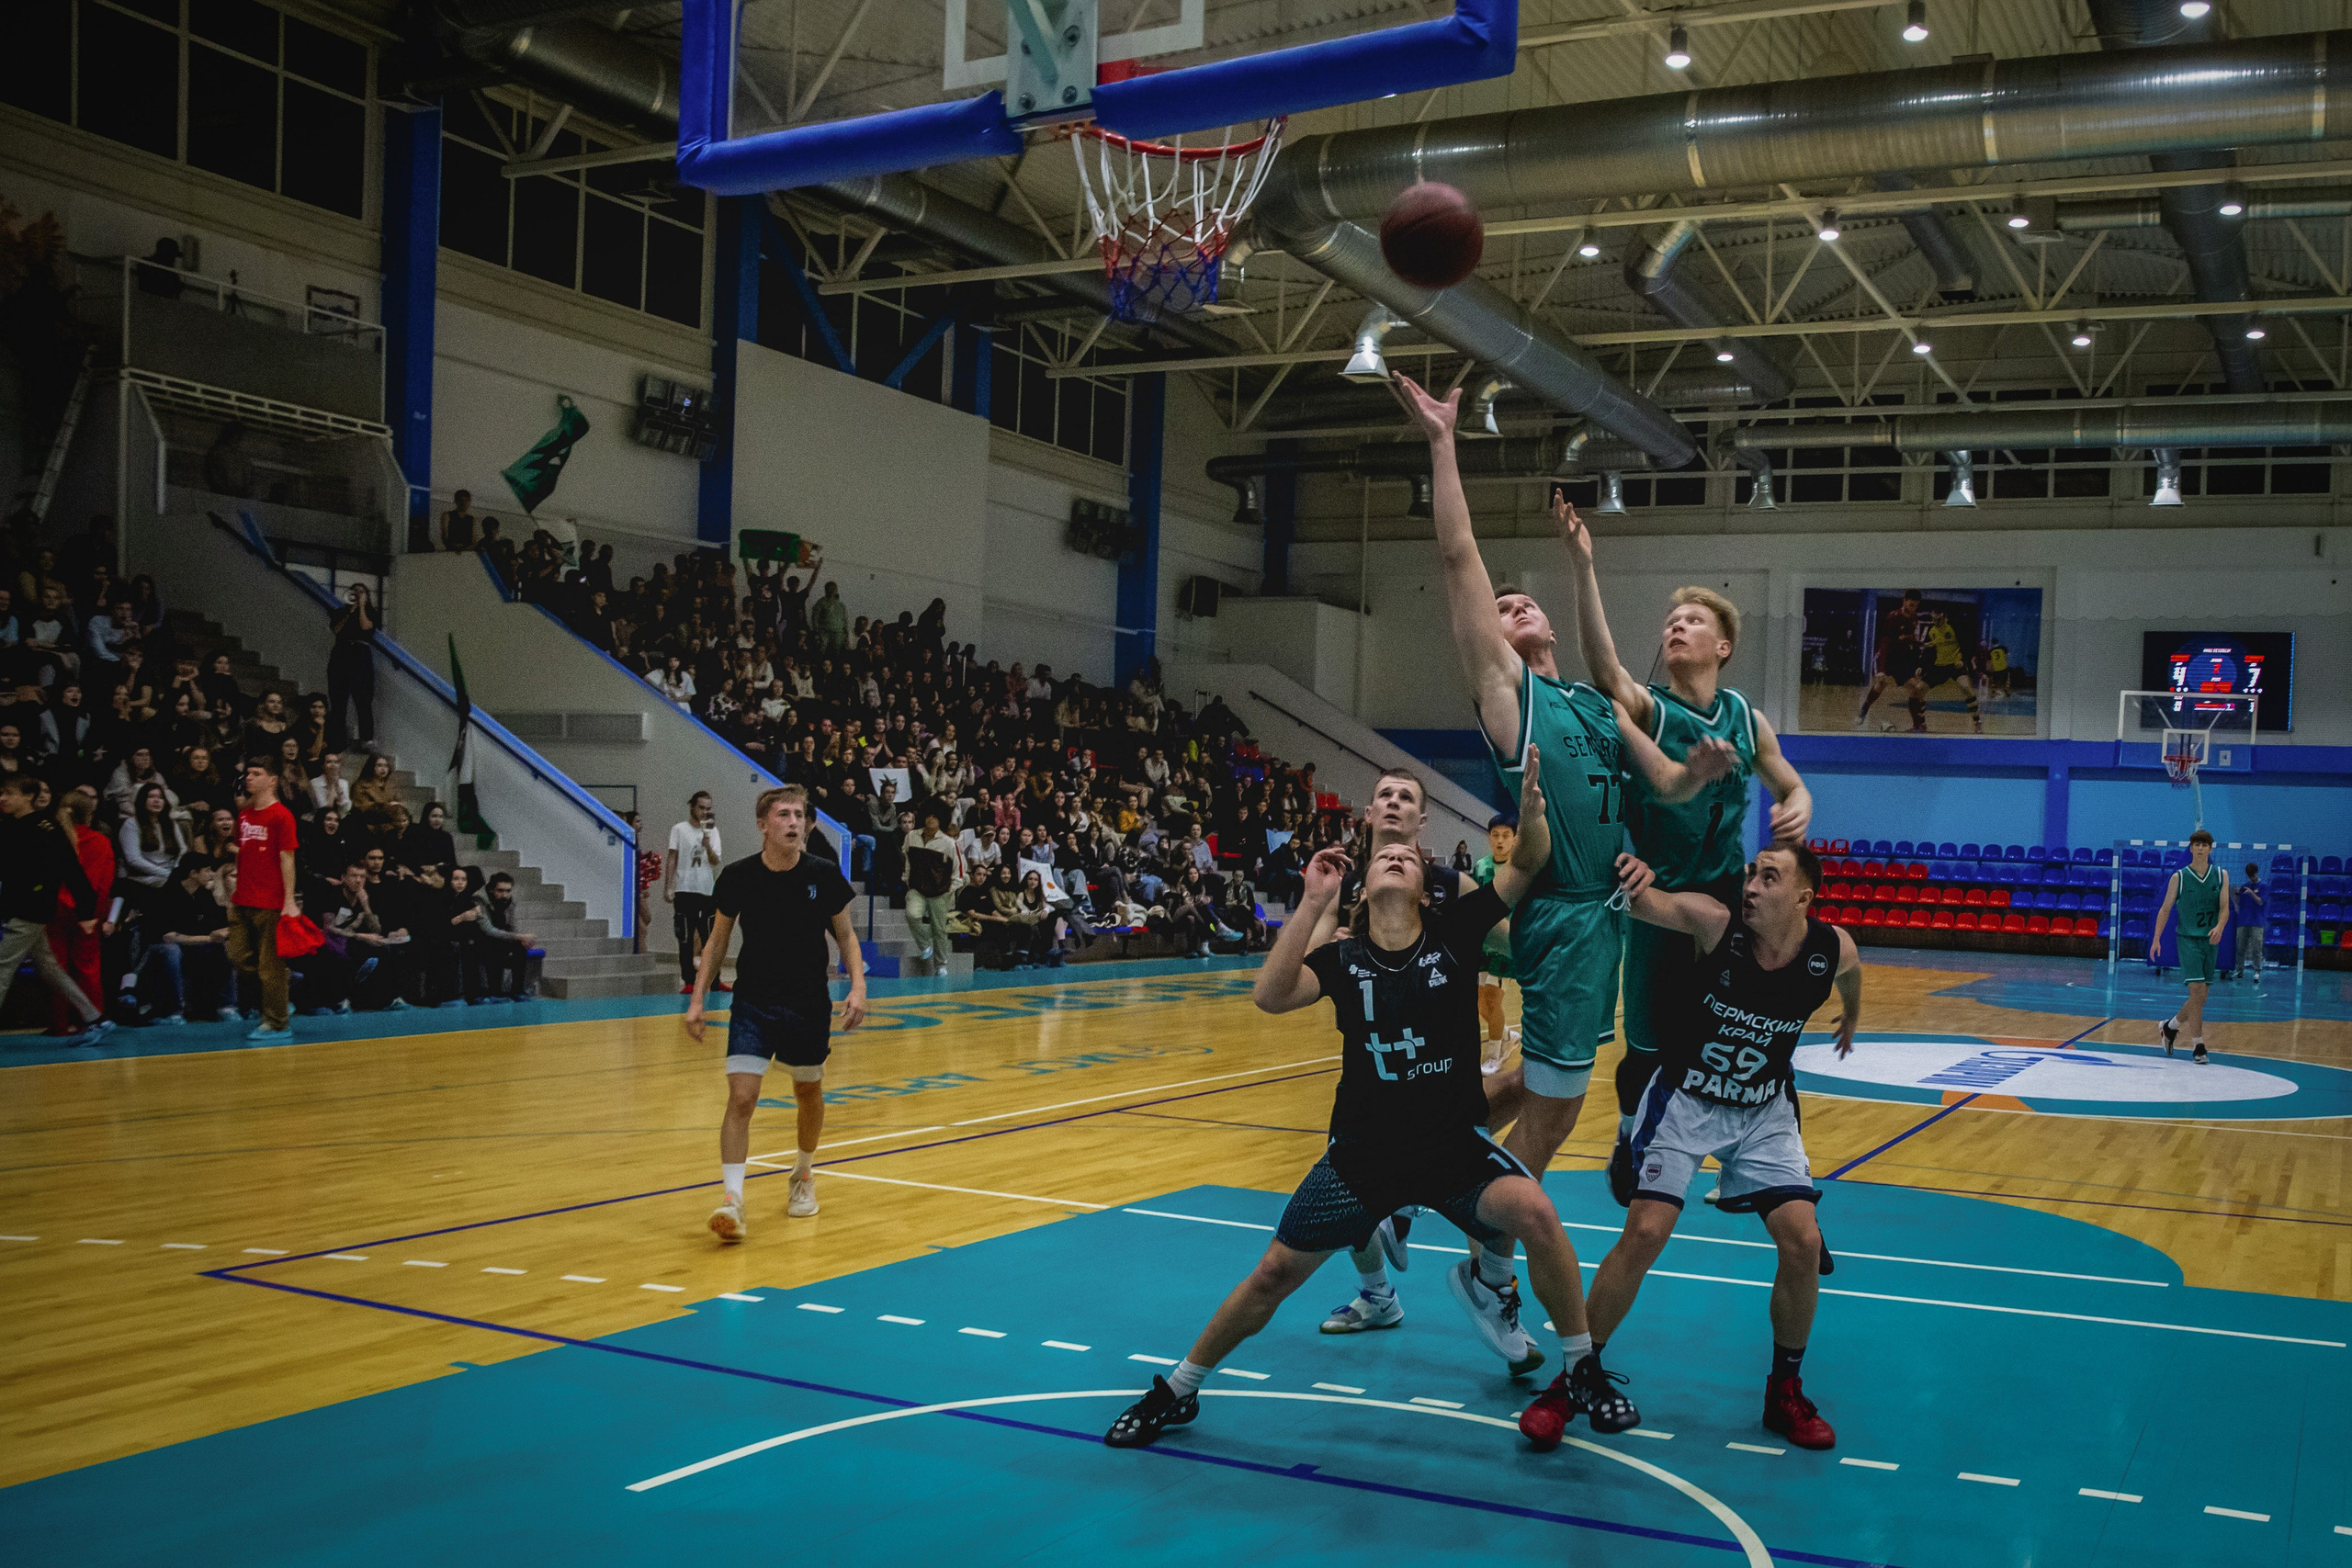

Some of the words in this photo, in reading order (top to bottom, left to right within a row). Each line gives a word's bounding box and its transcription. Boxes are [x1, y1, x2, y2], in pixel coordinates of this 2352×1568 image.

[2248, 668, 2261, 687] 7
[2196, 910, 2215, 929] 27
[1359, 979, 1374, 1021] 1
[1703, 993, 1804, 1034] ПЕРМСКИЙ
[1718, 1023, 1773, 1047] КРАЙ
[1701, 1042, 1769, 1081] 69
[1682, 1067, 1776, 1105] PARMA
